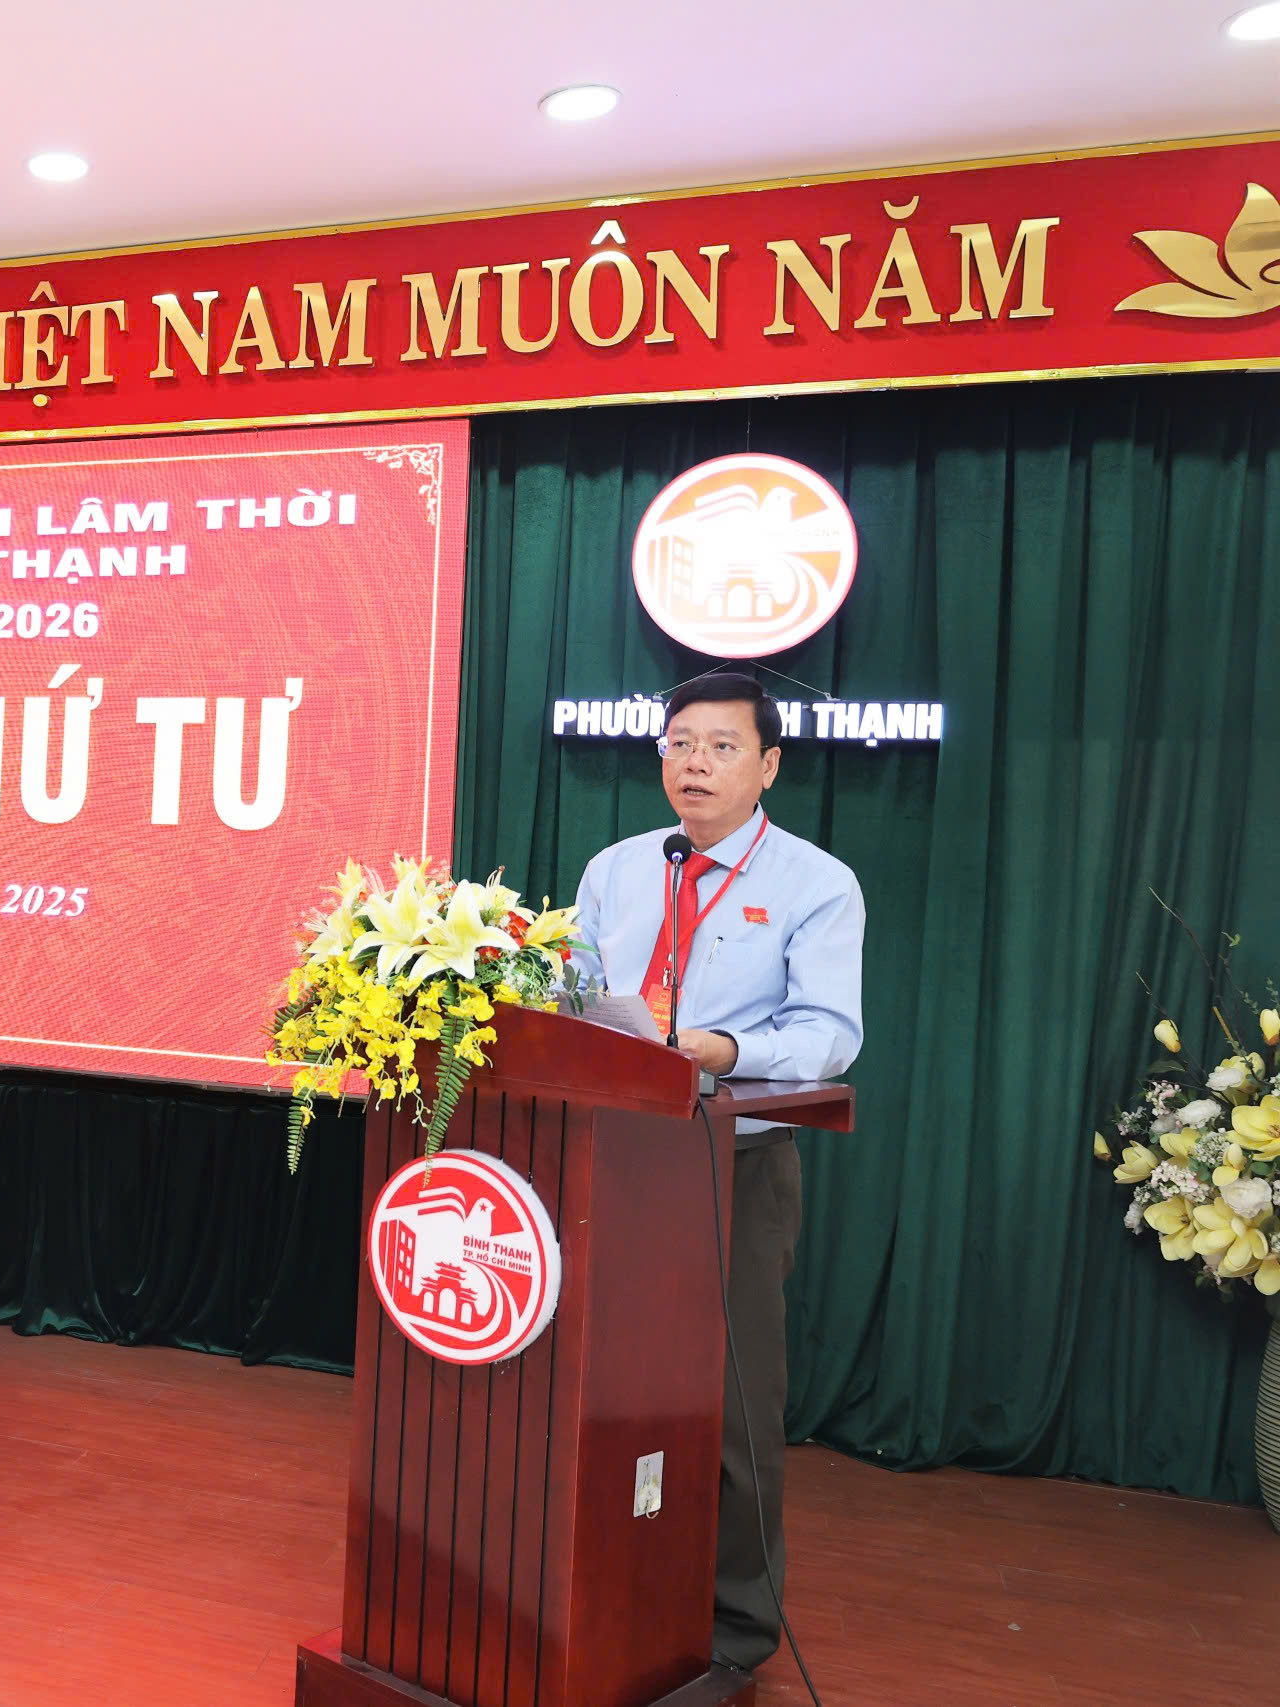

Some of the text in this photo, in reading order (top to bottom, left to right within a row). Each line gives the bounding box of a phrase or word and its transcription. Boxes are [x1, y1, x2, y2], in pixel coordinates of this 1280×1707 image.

[149, 278, 377, 380] NAM
[400, 219, 730, 361] MUÔN
[763, 195, 1060, 337] NĂM
[36, 498, 169, 536] LÂM
[197, 488, 357, 529] THỜI
[553, 692, 666, 737] PHƯỜN
[812, 702, 943, 747] THẠNH
[136, 677, 305, 832] TƯ
[0, 884, 90, 918] 2025
[463, 1233, 490, 1252] BÌNH
[509, 1261, 531, 1273] MINH
